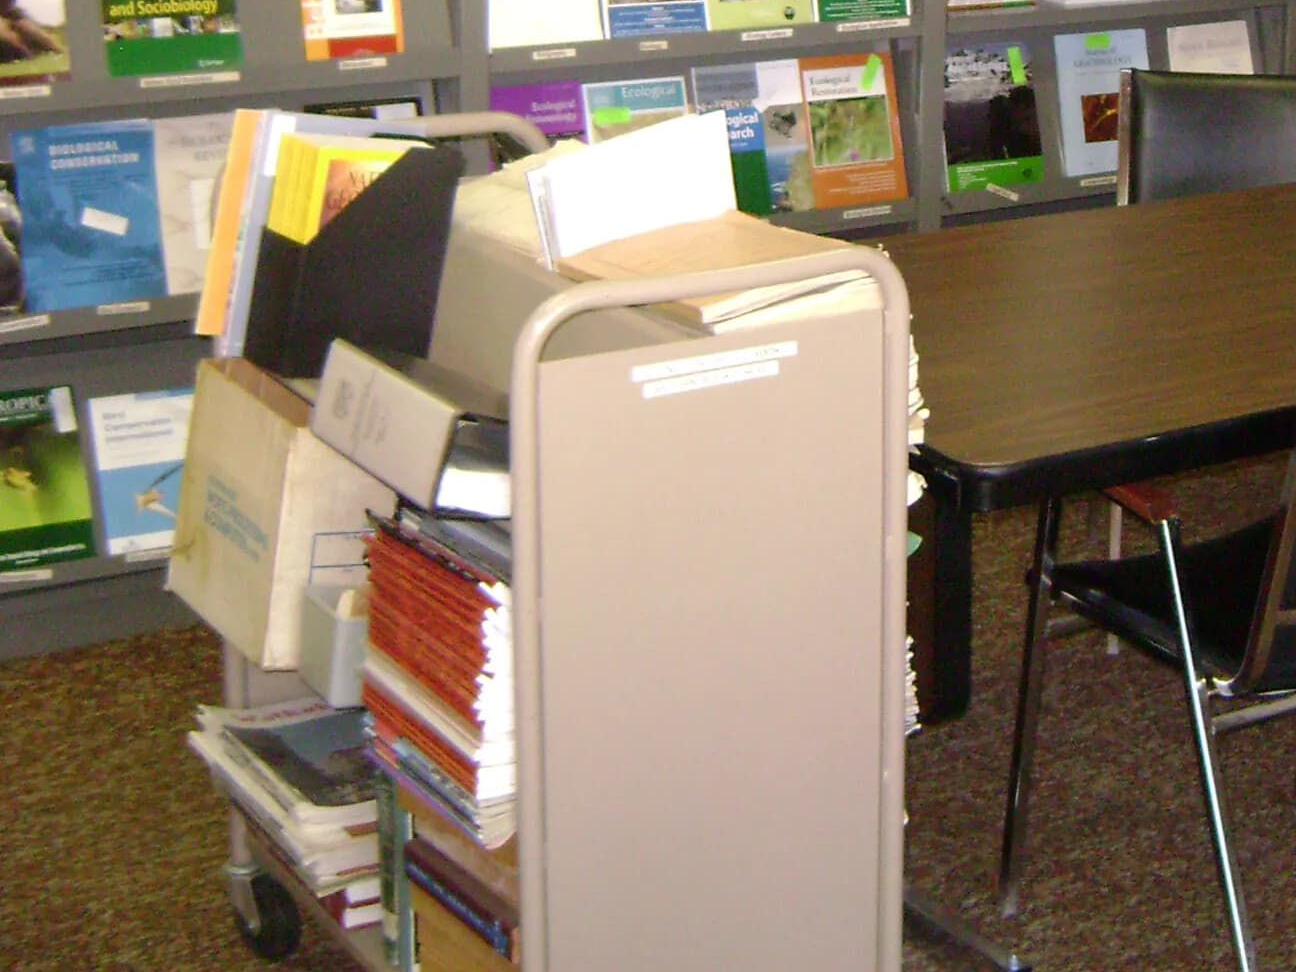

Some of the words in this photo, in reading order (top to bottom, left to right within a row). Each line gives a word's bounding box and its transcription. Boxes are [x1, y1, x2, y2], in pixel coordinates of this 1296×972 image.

[109, 2, 135, 17] and
[621, 85, 677, 101] Ecological
[727, 112, 759, 127] ogical
[729, 126, 755, 140] arch
[48, 139, 120, 158] BIOLOGICAL
[50, 151, 140, 171] CONSERVATION
